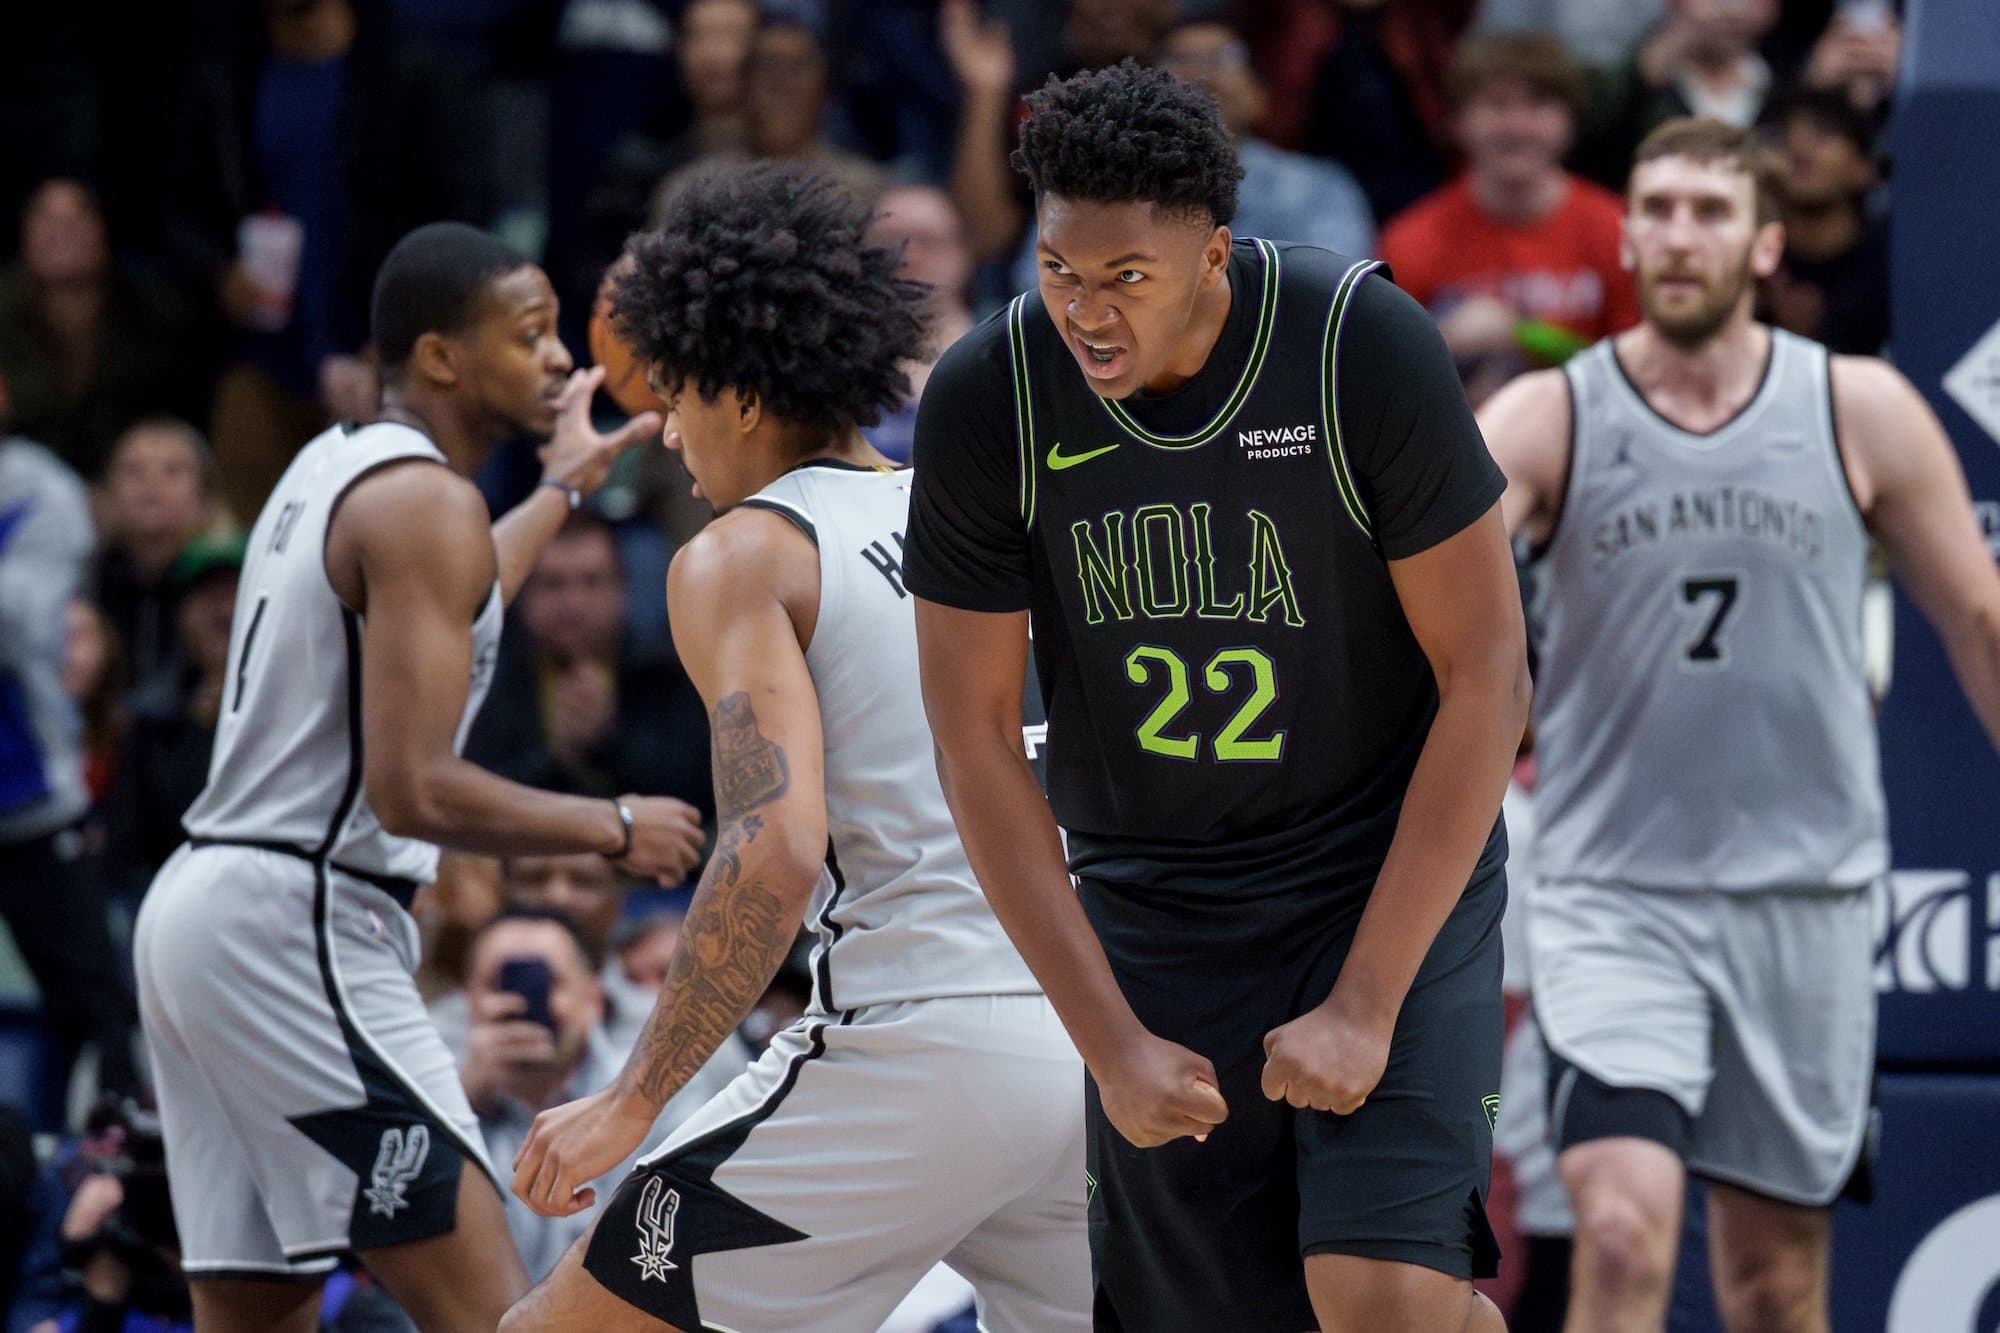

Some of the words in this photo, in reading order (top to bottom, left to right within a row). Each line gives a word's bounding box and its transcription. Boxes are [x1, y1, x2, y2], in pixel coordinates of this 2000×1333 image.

[1238, 424, 1316, 448] NEWAGE
[1247, 445, 1312, 460] PRODUCTS
[1592, 501, 1658, 560] SAN
[1668, 487, 1823, 558] ANTONIO
[1071, 503, 1305, 626] NOLA
[1681, 575, 1741, 664] 7
[1124, 643, 1288, 763] 22
